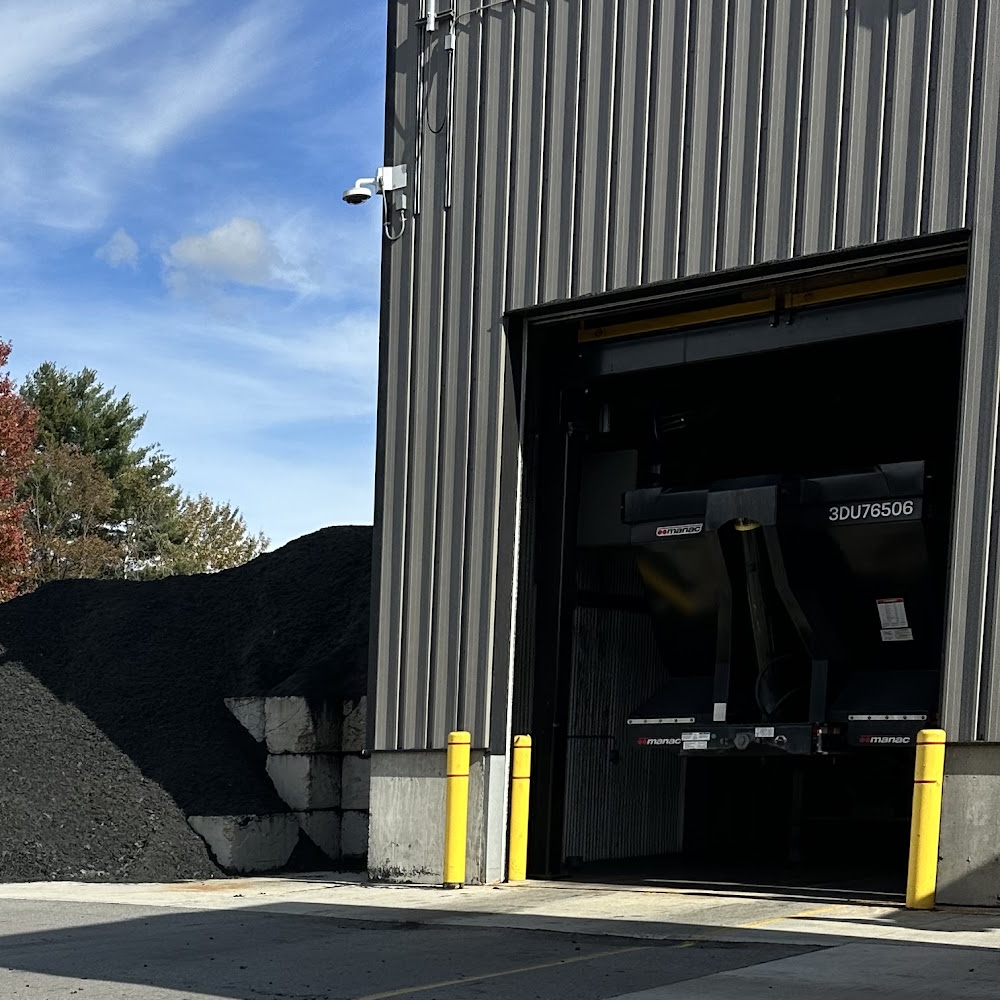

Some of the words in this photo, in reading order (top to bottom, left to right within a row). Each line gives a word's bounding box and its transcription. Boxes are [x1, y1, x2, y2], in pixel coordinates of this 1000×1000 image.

[828, 500, 914, 521] 3DU76506
[667, 526, 701, 534] manac
[870, 736, 911, 744] manac
